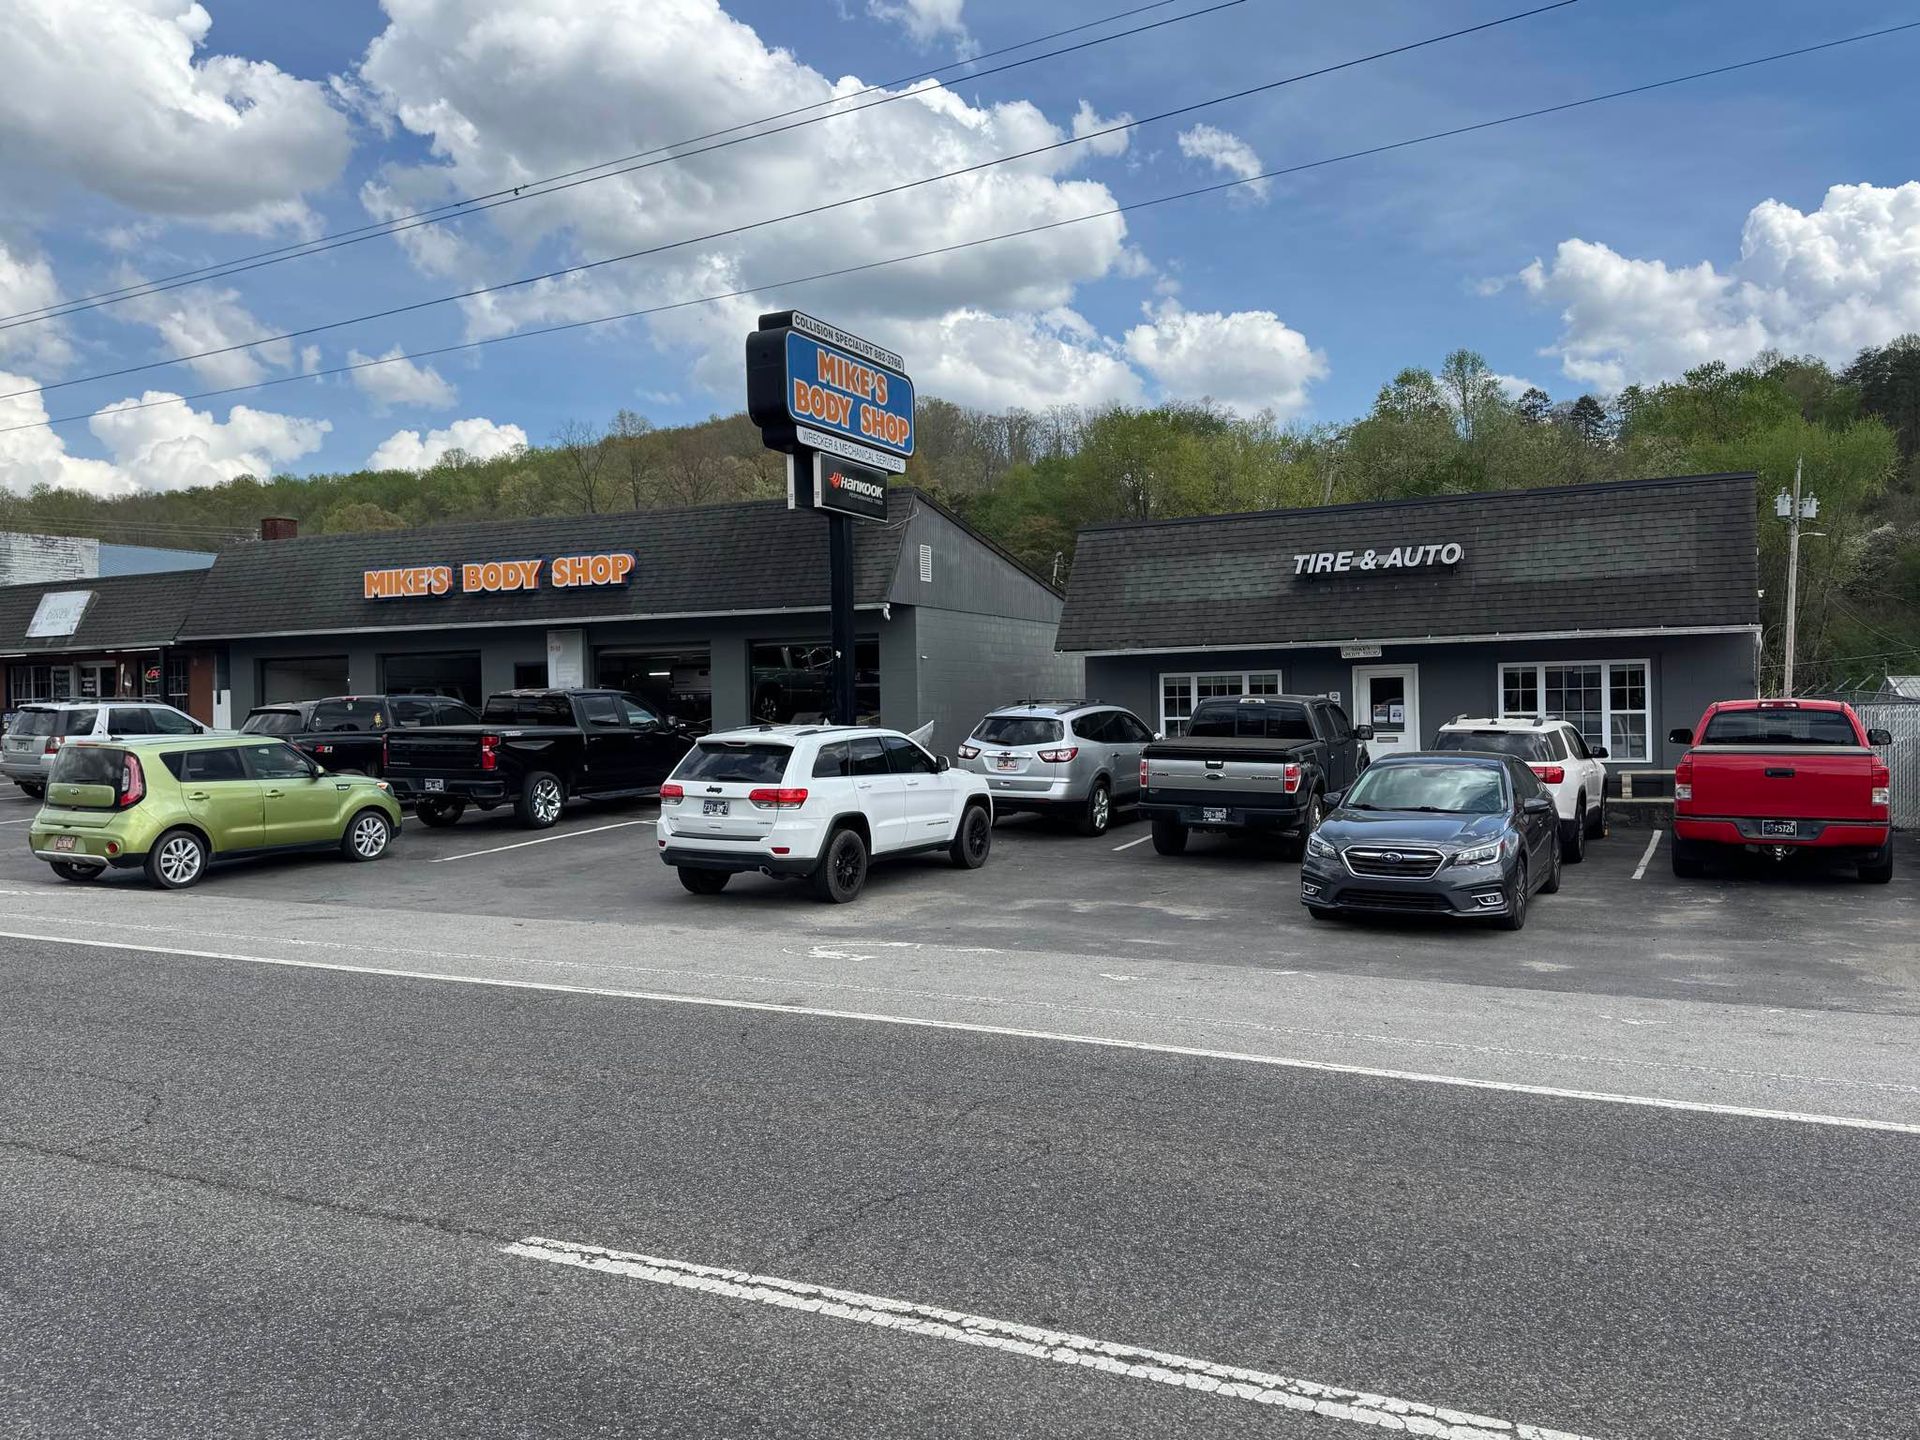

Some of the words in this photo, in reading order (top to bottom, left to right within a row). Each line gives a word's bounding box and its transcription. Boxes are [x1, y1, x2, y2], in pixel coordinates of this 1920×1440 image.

[795, 315, 834, 340] COLLISION
[835, 332, 873, 355] SPECIALIST
[817, 348, 887, 405] MIKE'S
[794, 378, 853, 427] BODY
[860, 403, 909, 446] SHOP
[803, 430, 833, 449] WRECKER
[839, 442, 875, 463] MECHANICAL
[876, 453, 901, 470] SERVICES
[364, 566, 452, 599] MIKE'S
[462, 560, 545, 593] BODY
[552, 553, 636, 588] SHOP
[1293, 550, 1354, 575] TIRE
[1359, 549, 1377, 570] &
[1383, 543, 1462, 569] AUTO
